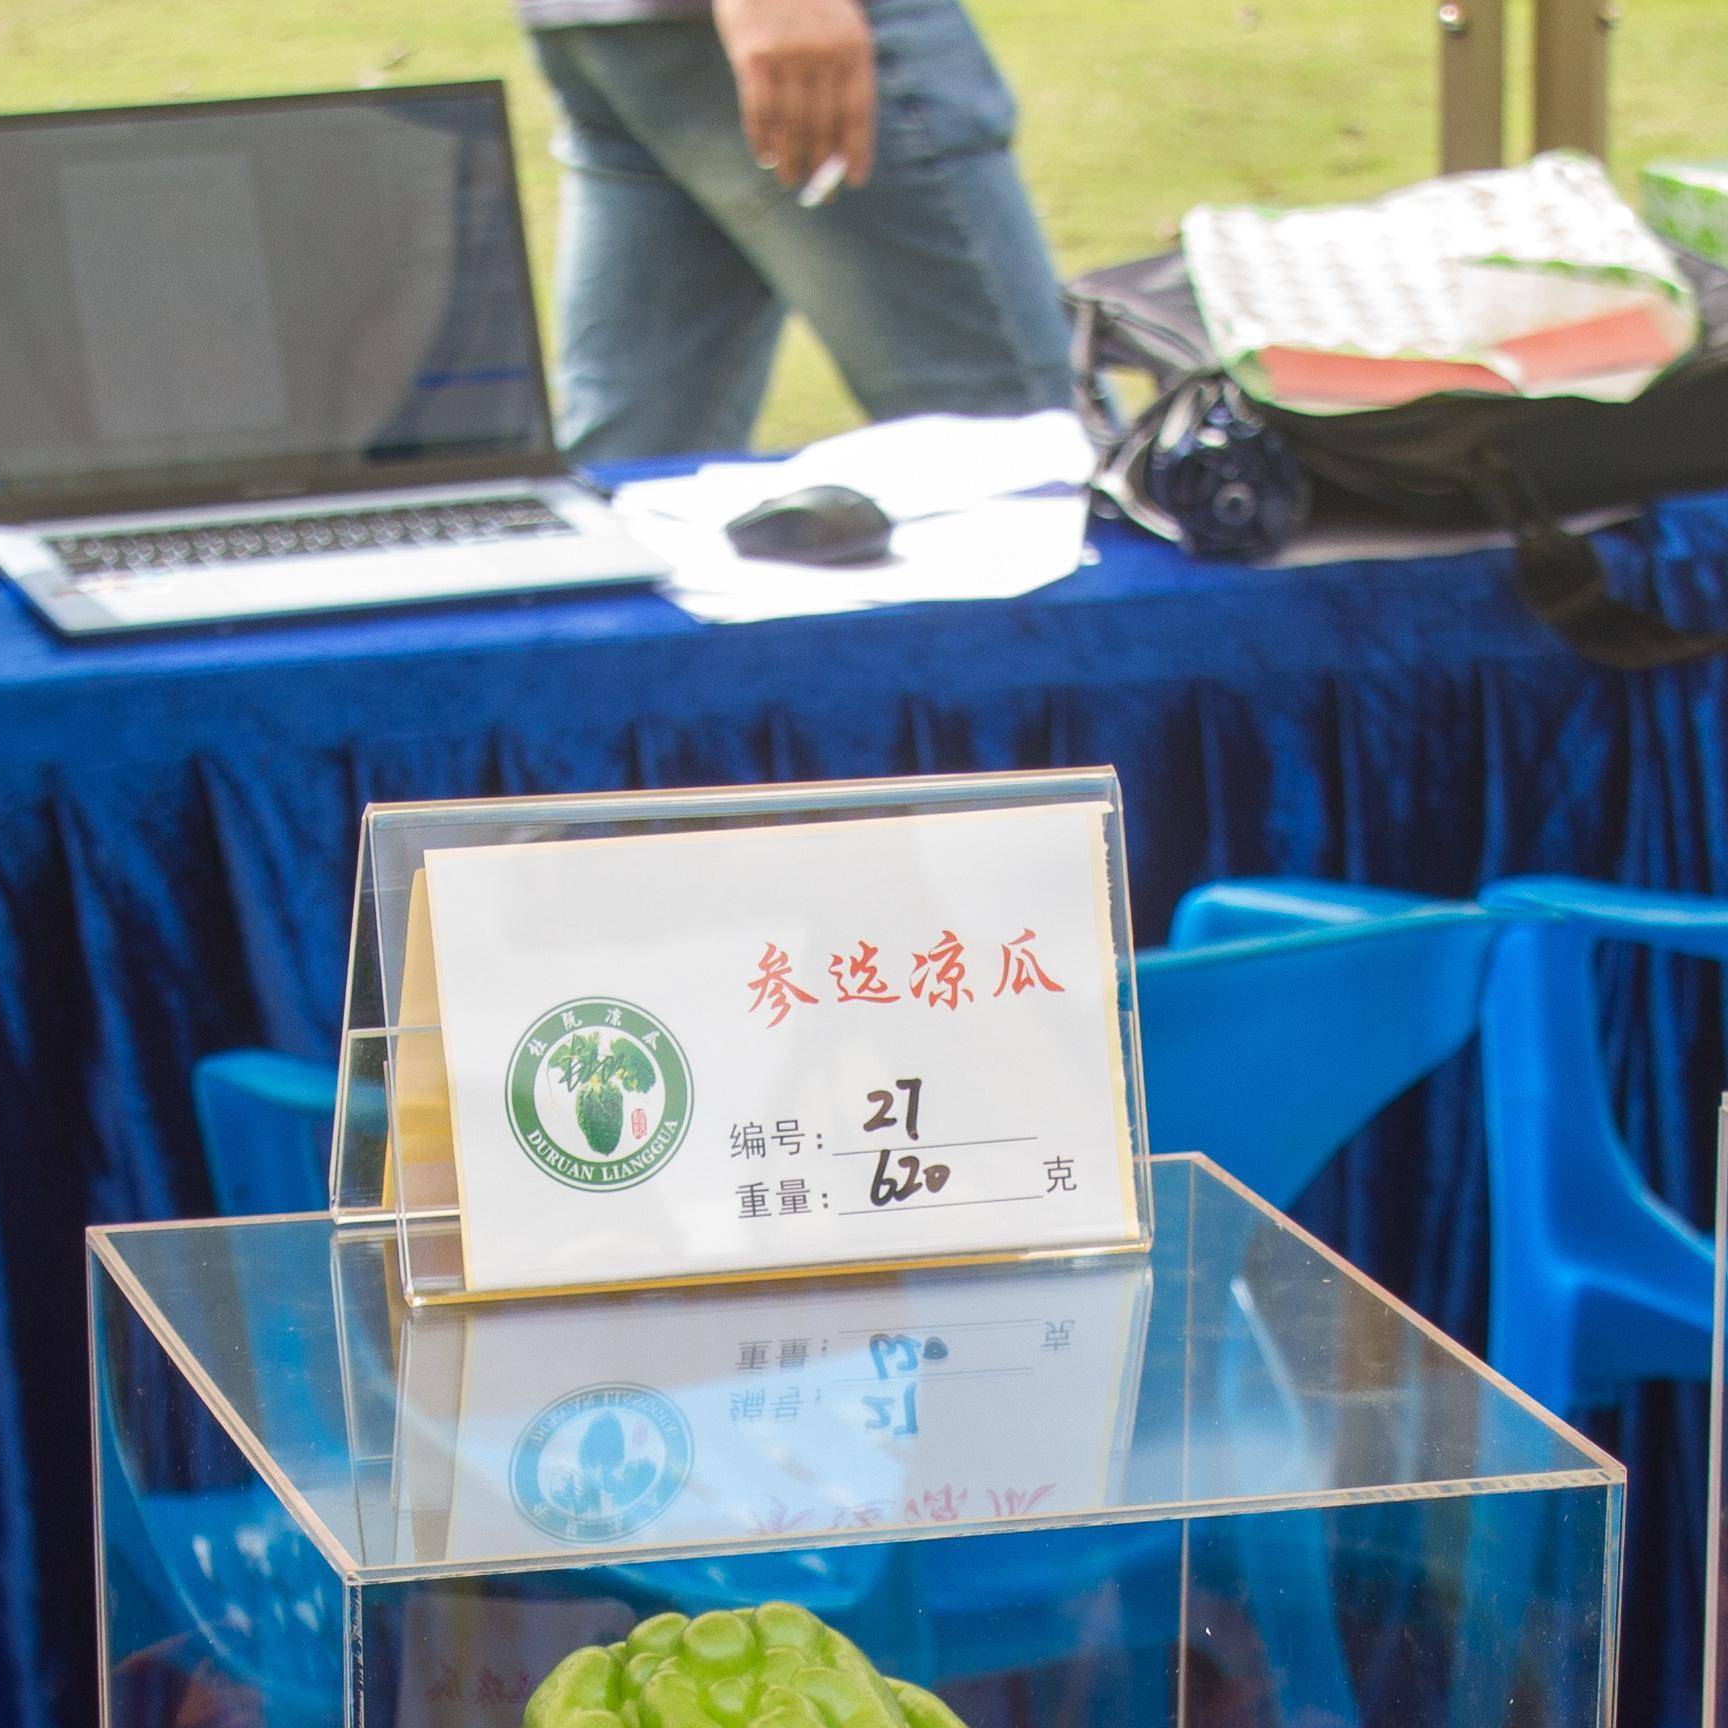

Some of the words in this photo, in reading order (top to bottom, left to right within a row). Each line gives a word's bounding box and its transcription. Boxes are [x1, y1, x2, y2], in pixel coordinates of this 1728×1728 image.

[747, 928, 1066, 1028] 参选凉瓜
[864, 1079, 919, 1140] 27
[527, 1130, 594, 1180] DURUAN
[602, 1120, 678, 1181] LIANGGUA
[871, 1149, 950, 1205] 620
[1044, 1156, 1078, 1193] 克
